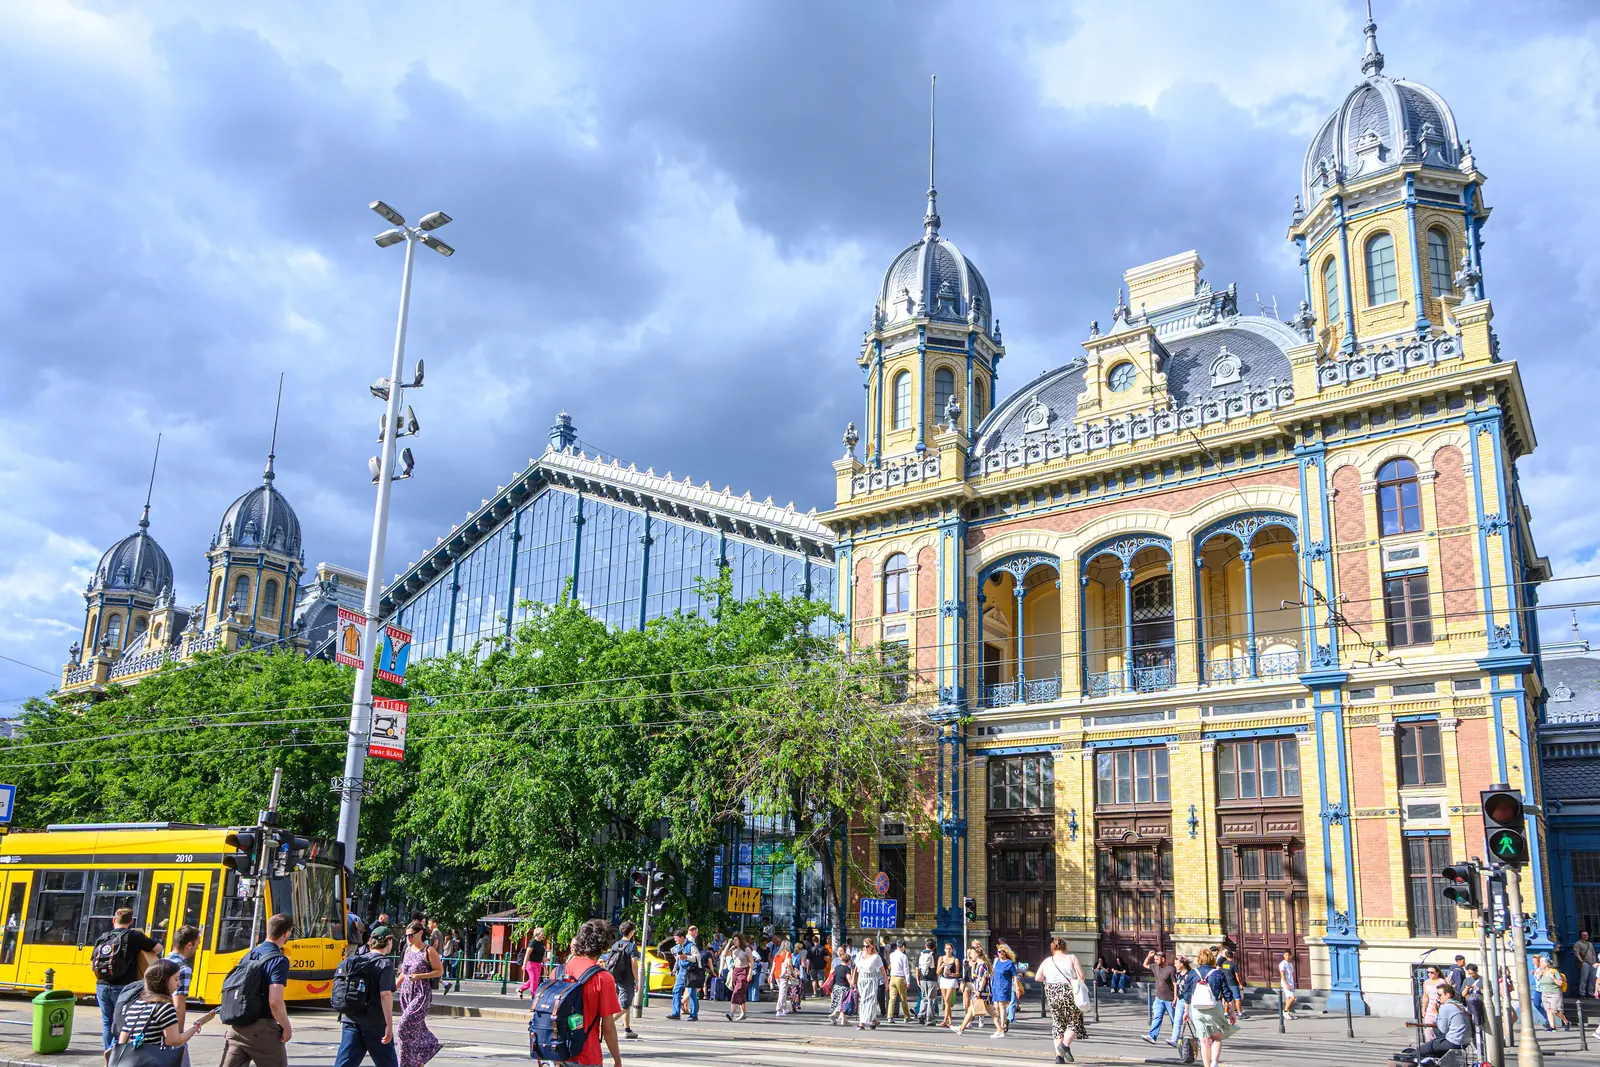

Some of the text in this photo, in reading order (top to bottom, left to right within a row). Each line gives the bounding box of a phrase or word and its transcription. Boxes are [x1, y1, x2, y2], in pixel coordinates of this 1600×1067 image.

[340, 610, 366, 626] CLEANING
[387, 628, 410, 642] REPAIR
[374, 700, 408, 712] TAILORS
[175, 854, 193, 862] 2010
[293, 959, 315, 968] 2010
